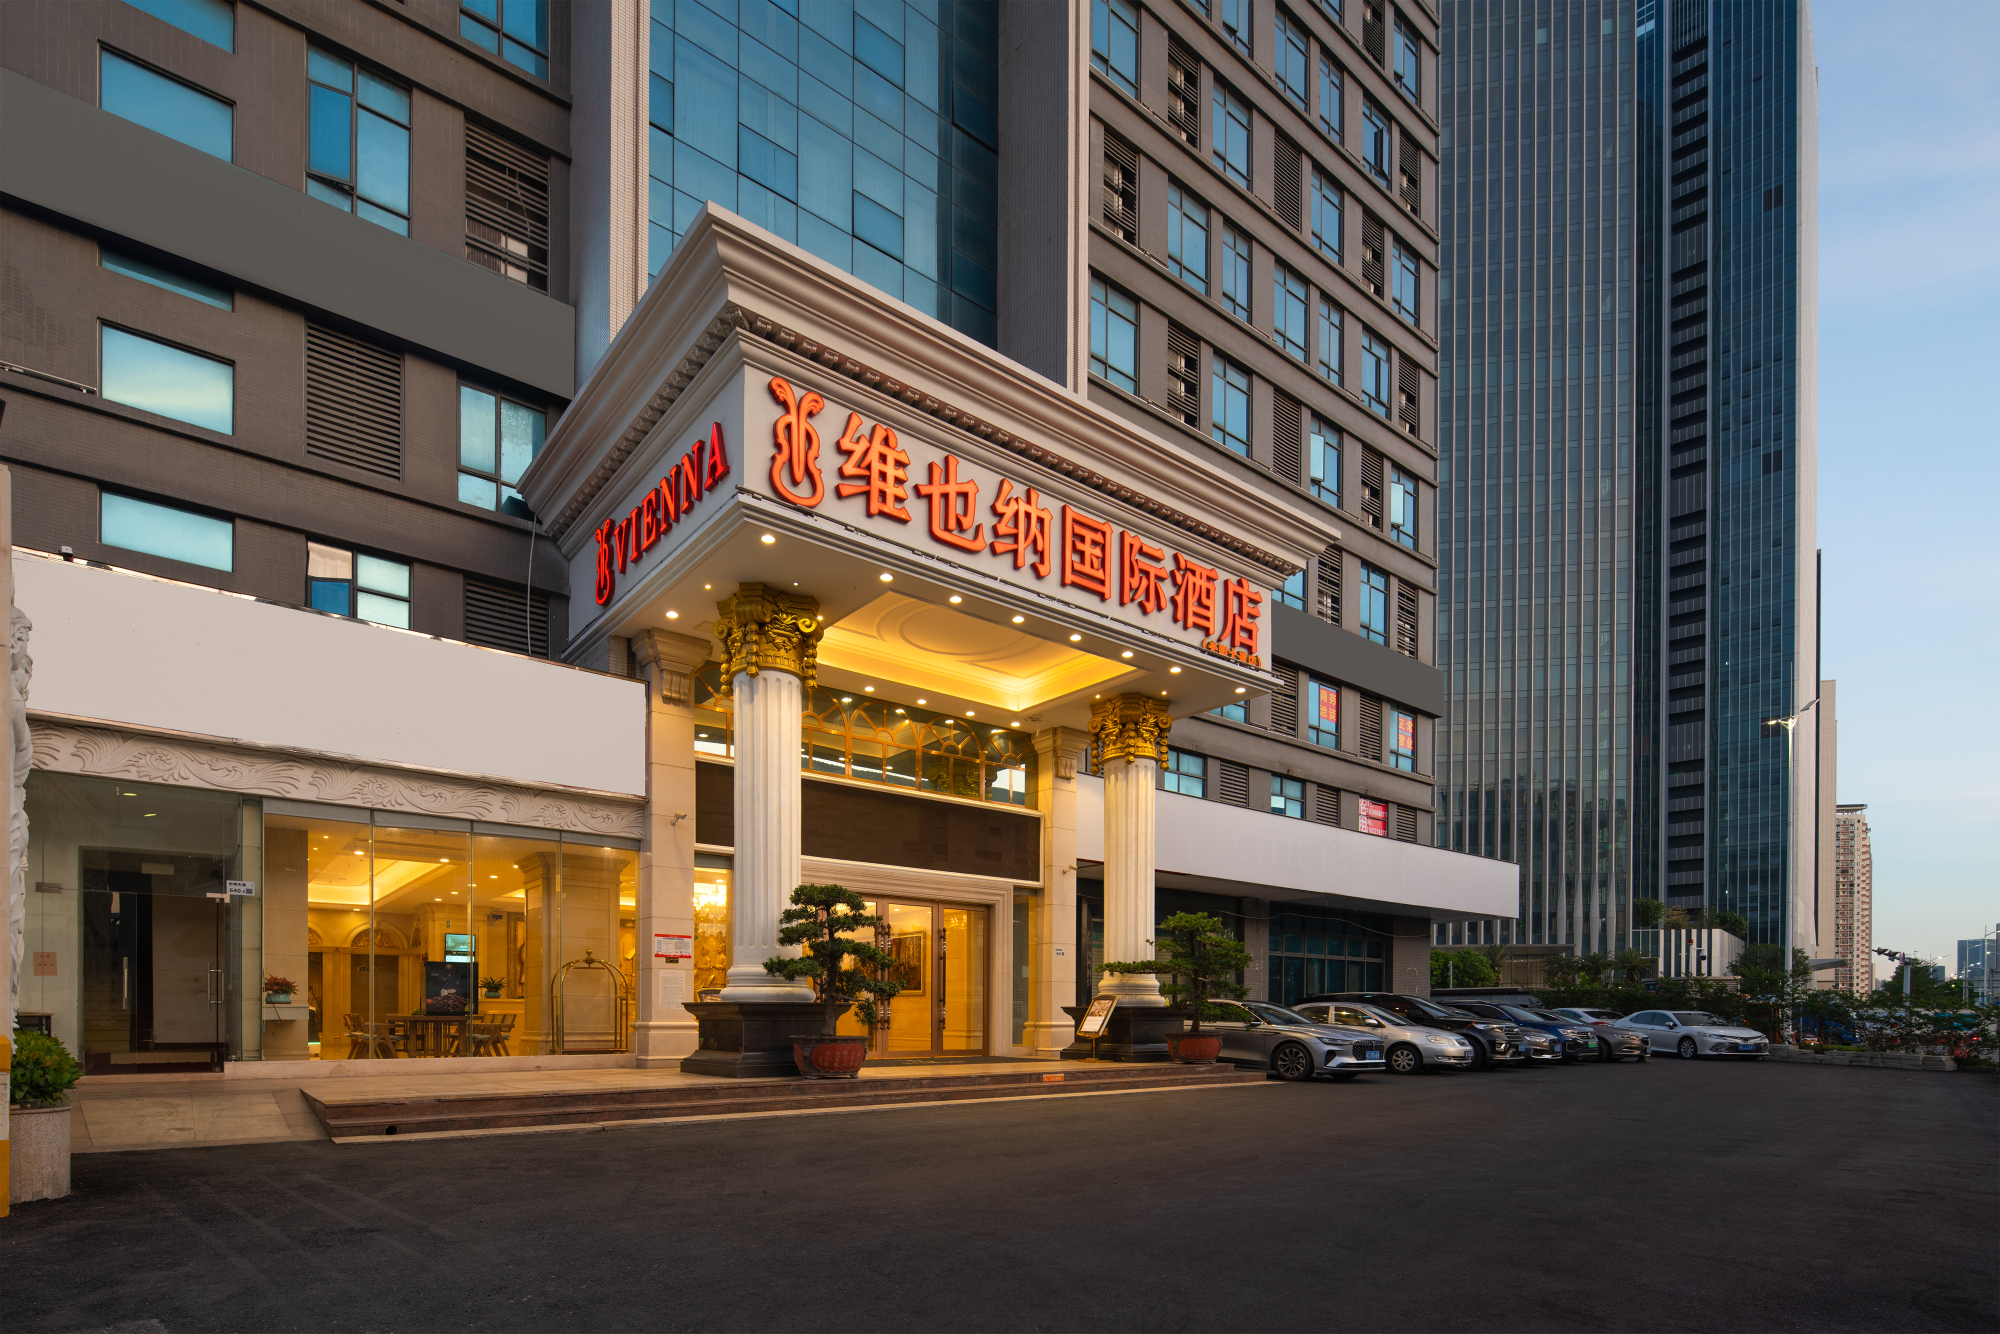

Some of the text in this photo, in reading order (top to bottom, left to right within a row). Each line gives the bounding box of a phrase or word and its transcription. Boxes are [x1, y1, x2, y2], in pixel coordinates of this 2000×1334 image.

[613, 421, 730, 575] VIENNA
[836, 412, 1264, 655] 维也纳国际酒店
[1320, 689, 1337, 706] 商务
[1320, 705, 1337, 722] 洽谈
[1399, 718, 1413, 733] 正常
[1399, 734, 1413, 750] 营业
